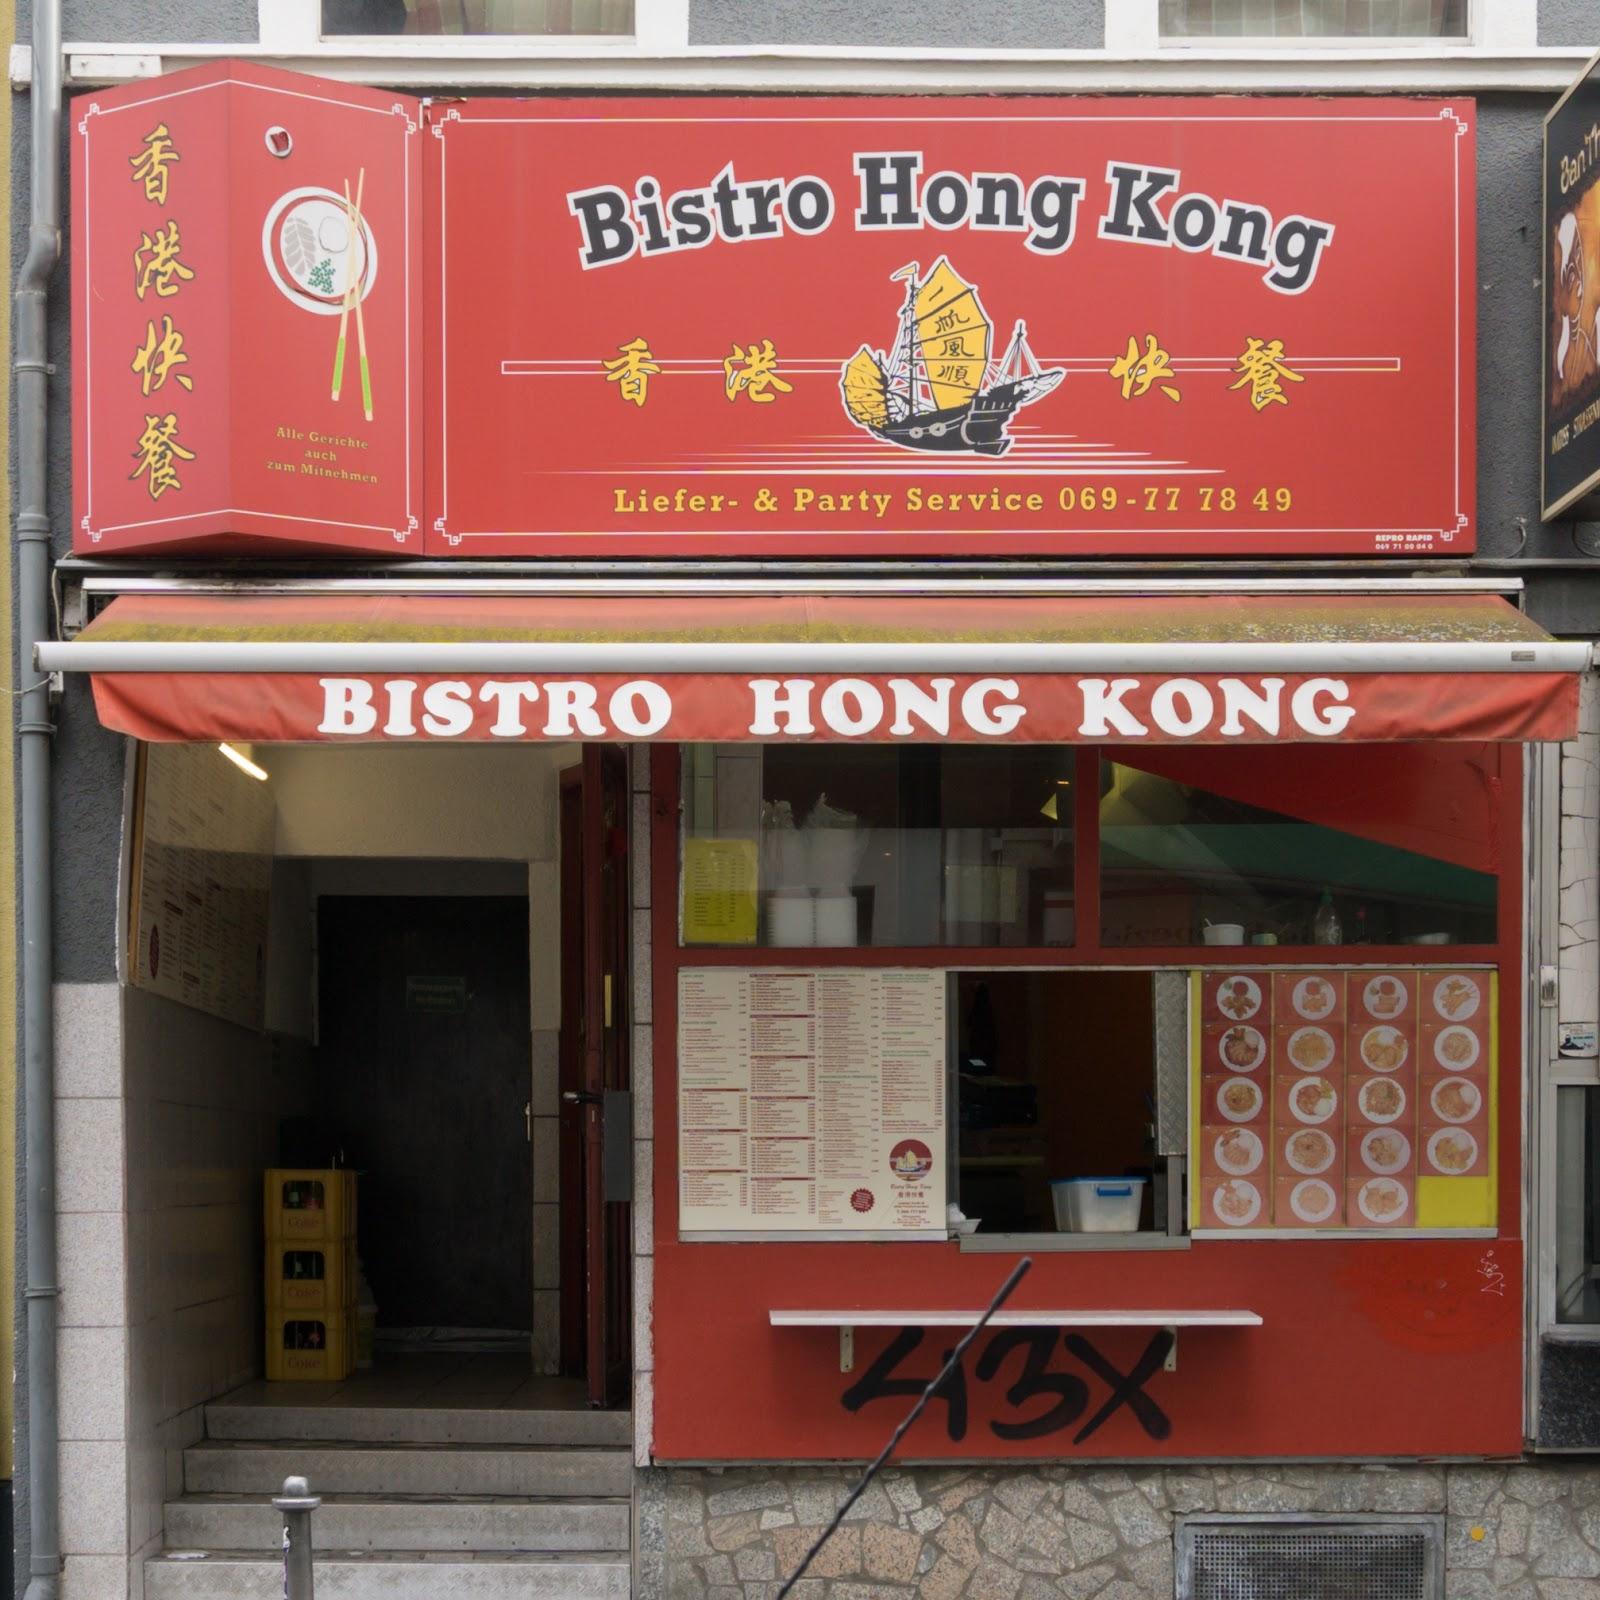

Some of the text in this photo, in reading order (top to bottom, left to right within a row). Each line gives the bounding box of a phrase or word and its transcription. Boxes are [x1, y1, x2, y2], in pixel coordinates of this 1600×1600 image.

[567, 151, 1334, 295] Bistro Hong Kong
[129, 122, 196, 501] 香港快餐
[276, 426, 369, 449] Alle Gerichte
[304, 449, 337, 461] auch
[267, 461, 378, 483] zum Mitnehmen
[613, 488, 738, 513] Liefer-
[753, 488, 778, 512] &
[793, 488, 892, 517] Party
[906, 487, 1044, 512] Service
[1199, 487, 1237, 511] 78
[1252, 487, 1292, 511] 49
[1406, 534, 1433, 542] RAPID
[317, 677, 1356, 737] BISTRO HONG KONG
